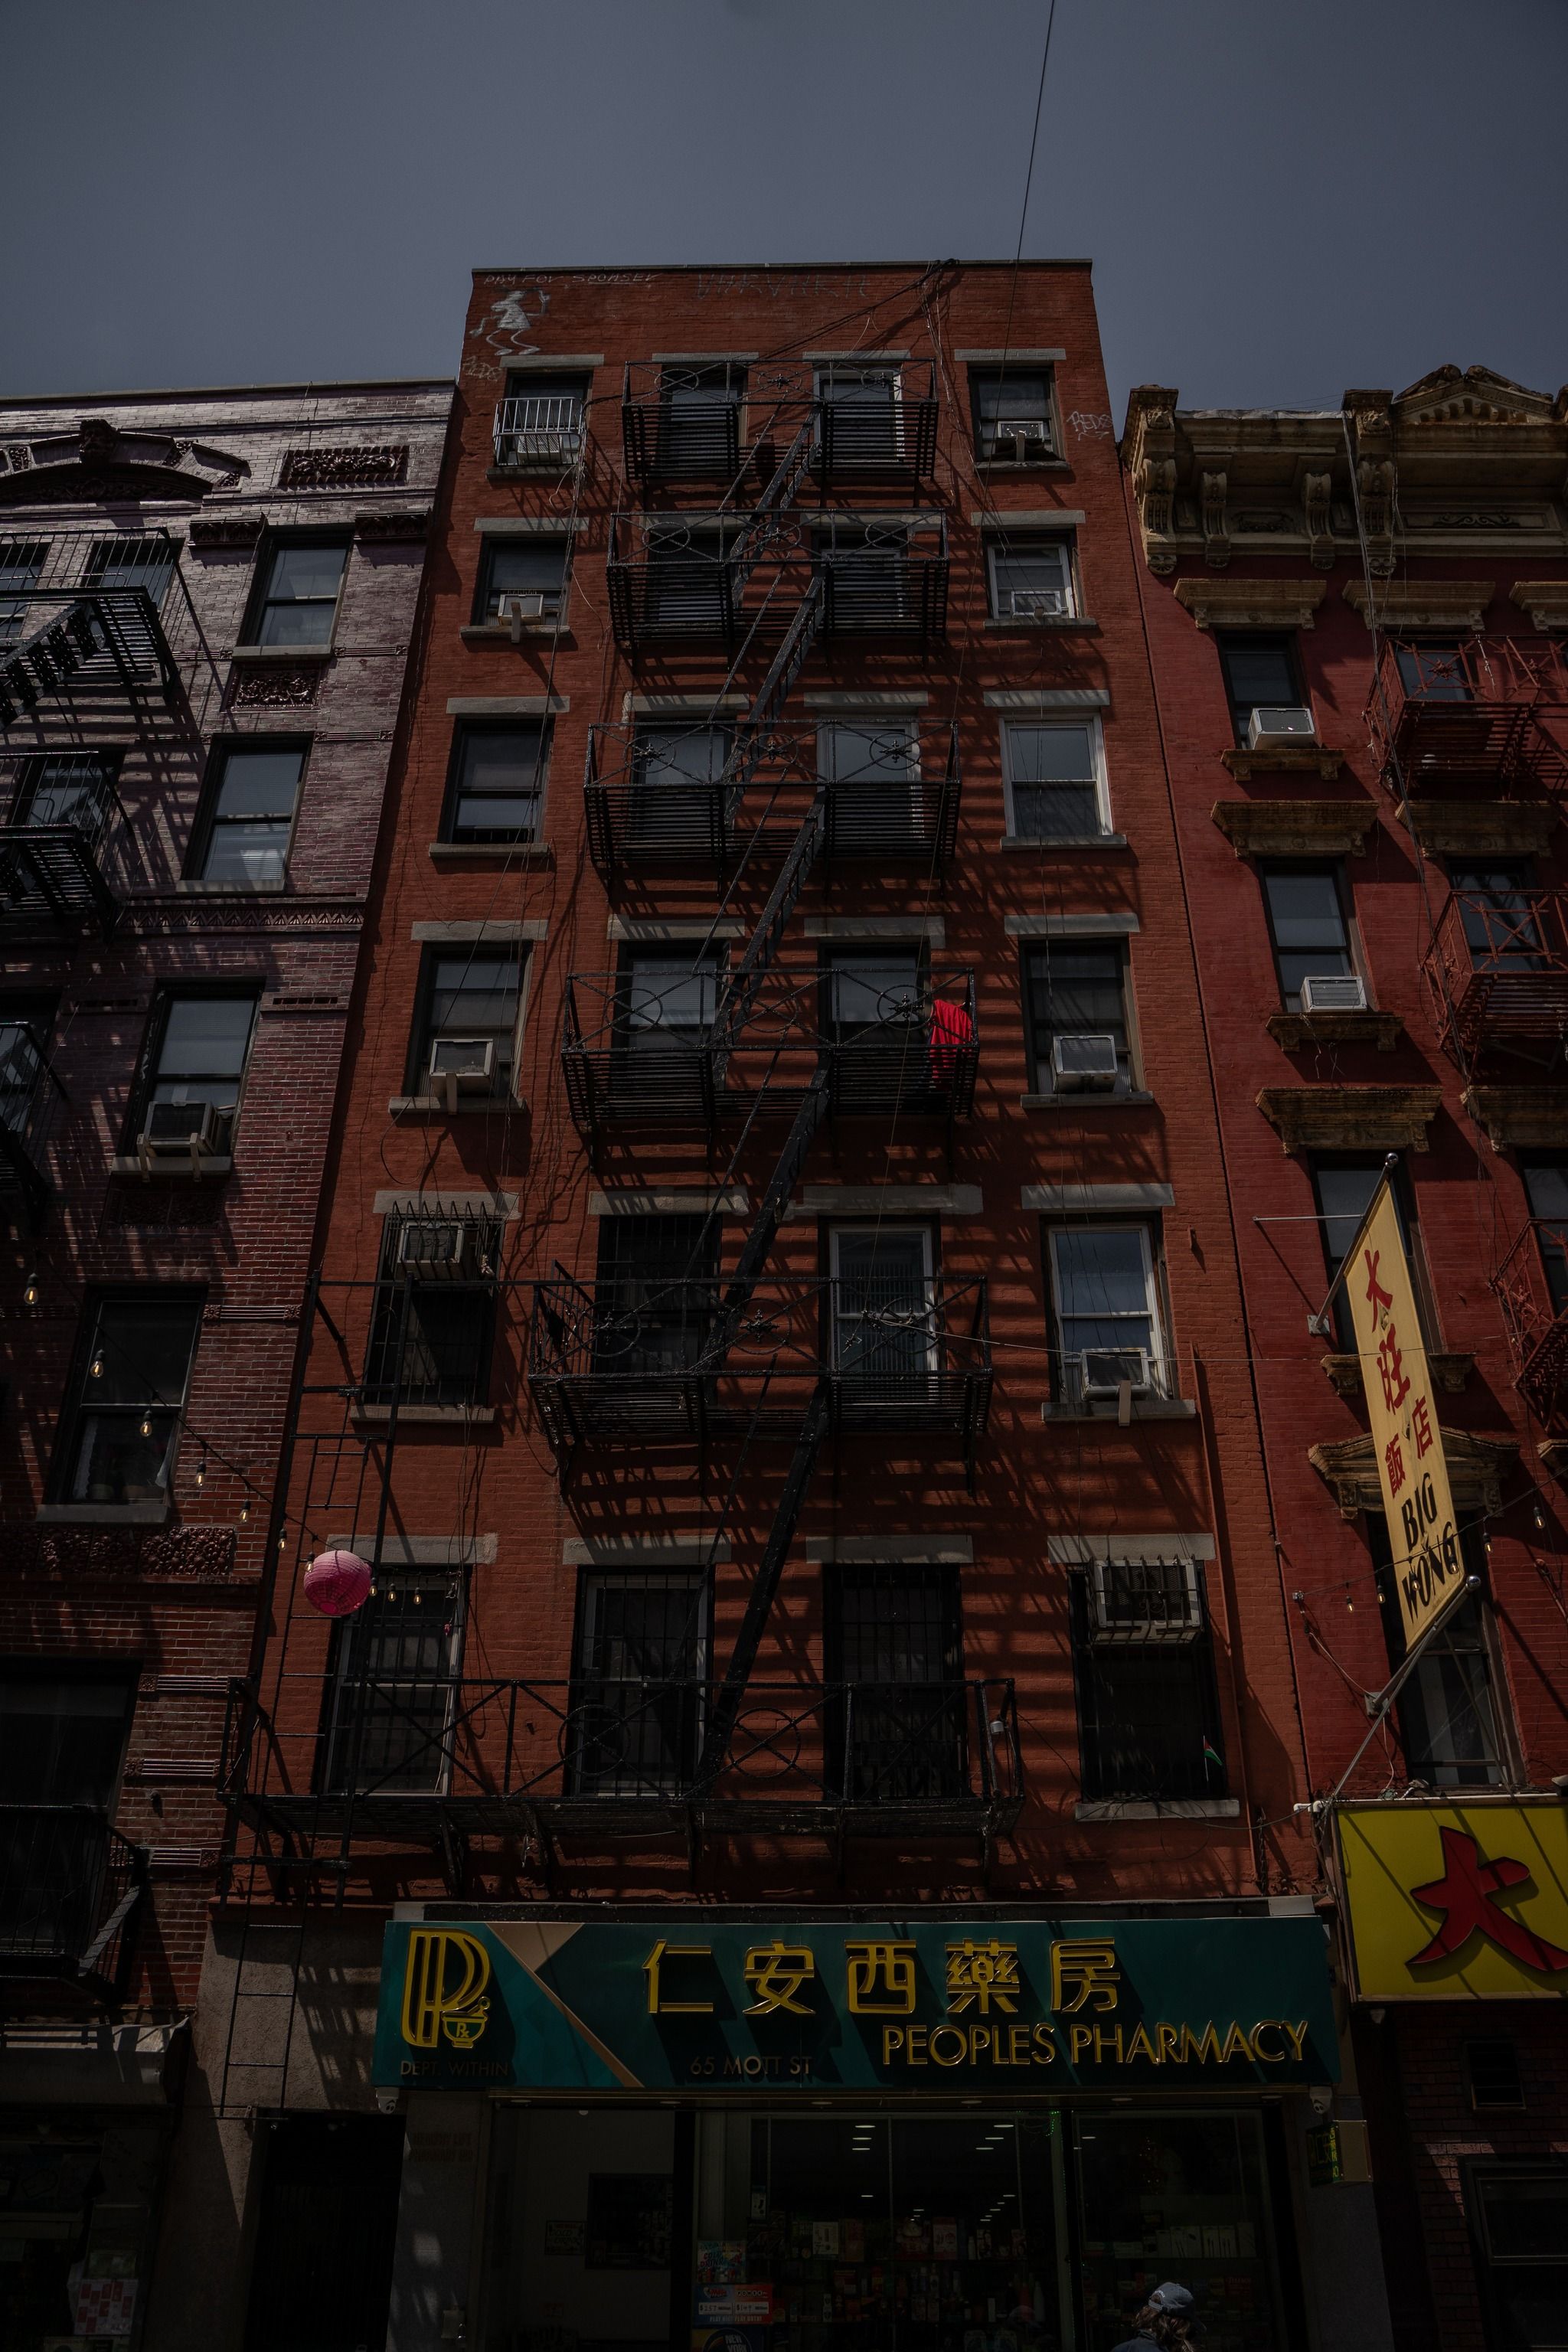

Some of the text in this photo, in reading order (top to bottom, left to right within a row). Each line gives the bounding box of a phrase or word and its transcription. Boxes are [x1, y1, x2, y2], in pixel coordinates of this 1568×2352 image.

[483, 275, 516, 285] PAY
[1401, 1472, 1438, 1553] BIG
[1401, 1521, 1459, 1624] WONG
[641, 1937, 1121, 2015] 仁安西藥房
[881, 2020, 1308, 2067] PEOPLES PHARMACY
[400, 2060, 509, 2077] DEPT. WITHIN
[689, 2056, 815, 2075] 65 MOTT ST
[724, 2334, 743, 2344] NEW
